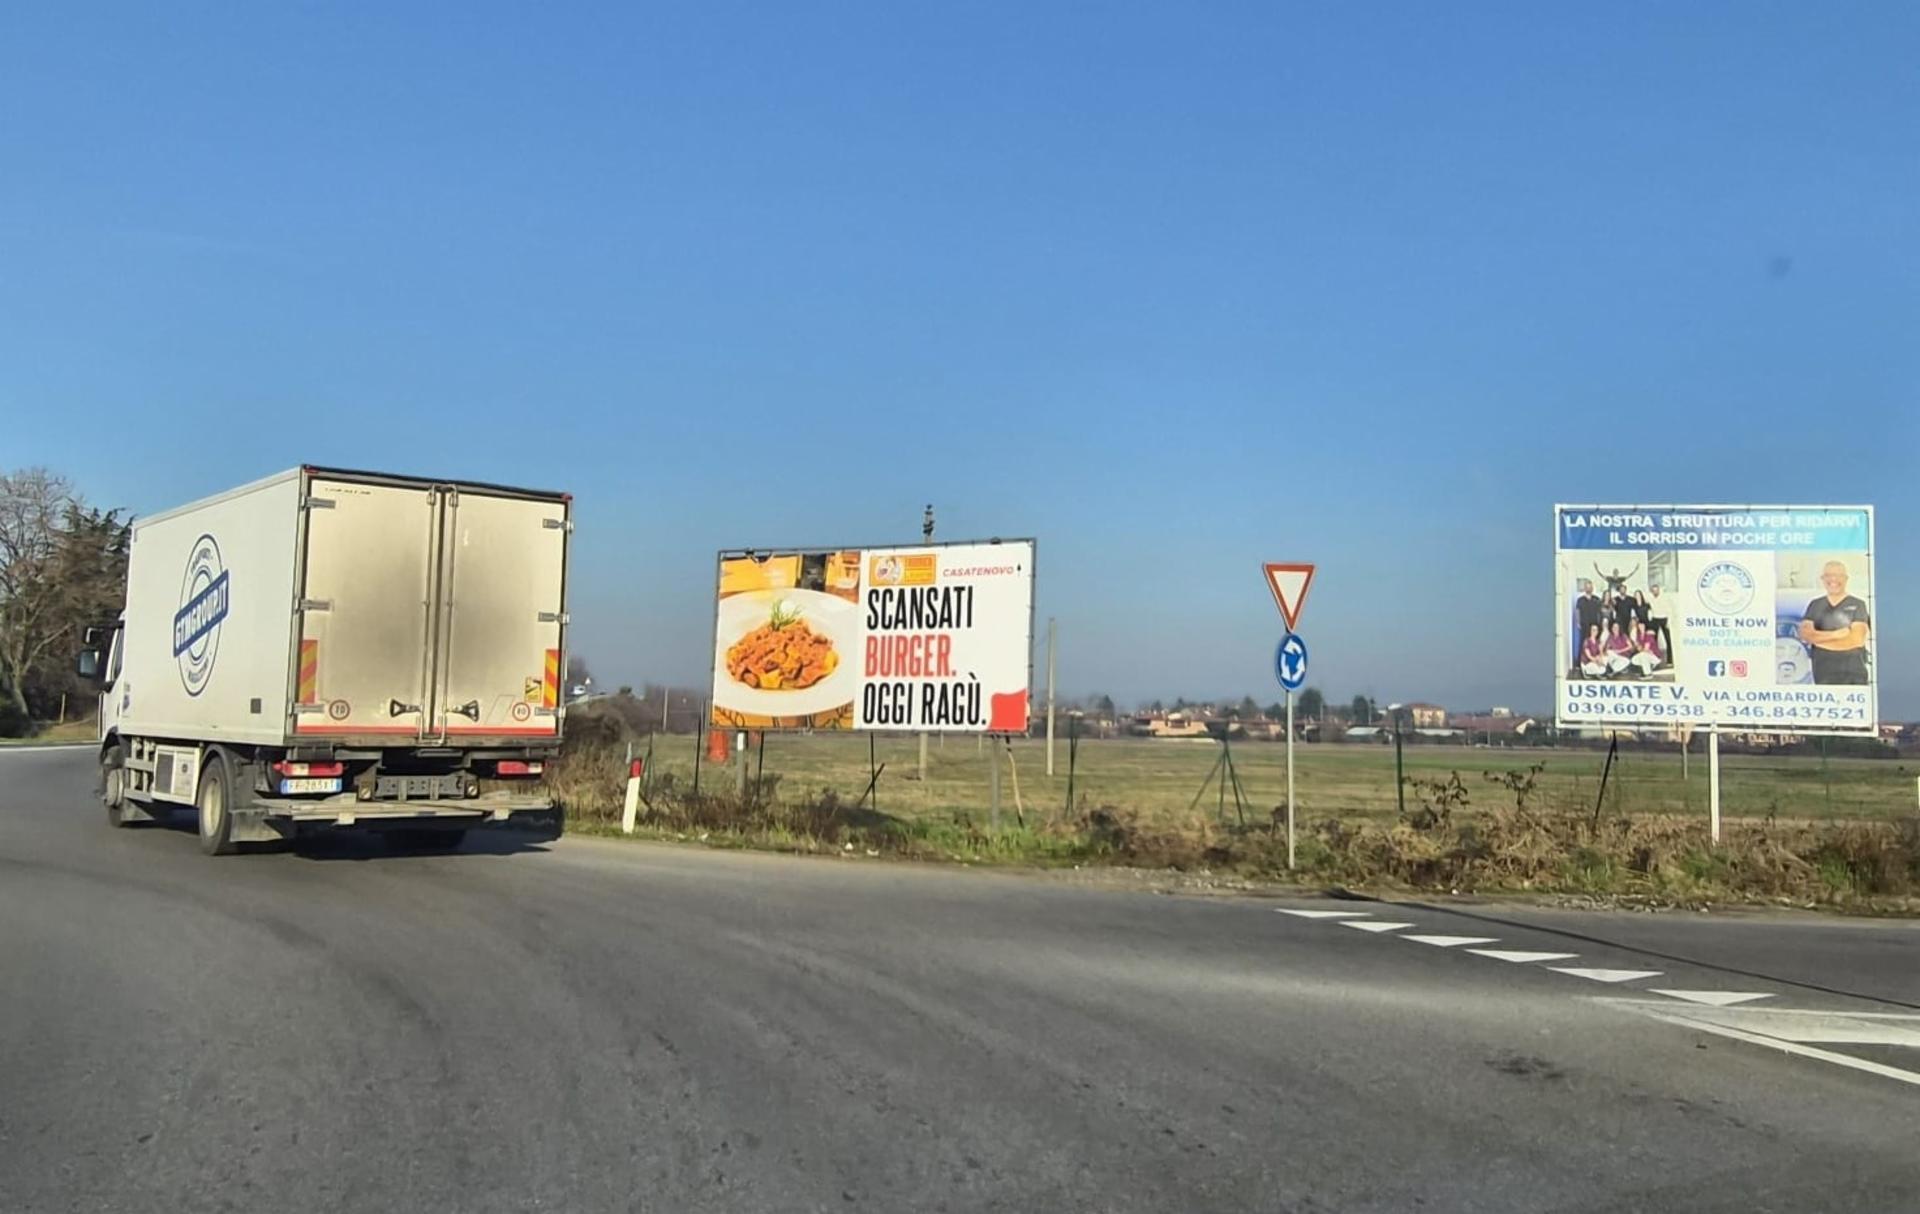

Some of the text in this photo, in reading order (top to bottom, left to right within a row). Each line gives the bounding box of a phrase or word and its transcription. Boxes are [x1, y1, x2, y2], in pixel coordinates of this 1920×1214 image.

[1566, 515, 1860, 528] LA NOSTRA STRUTTURA PER RIDARVI
[1610, 532, 1816, 544] IL SORRISO IN POCHE ORE
[943, 566, 1014, 577] CASATENOVO
[867, 585, 973, 630] SCANSATI
[1686, 618, 1768, 628] SMILE NOW
[1684, 638, 1720, 647] PAOLO
[864, 634, 957, 678] BURGER.
[1568, 684, 1689, 700] USMATE V.
[1703, 691, 1730, 701] VIA
[1846, 693, 1866, 704] 46
[863, 672, 987, 726] OGGI RAGÙ.
[1568, 702, 1705, 717] 039.6079538
[1727, 705, 1866, 720] 346.8437521
